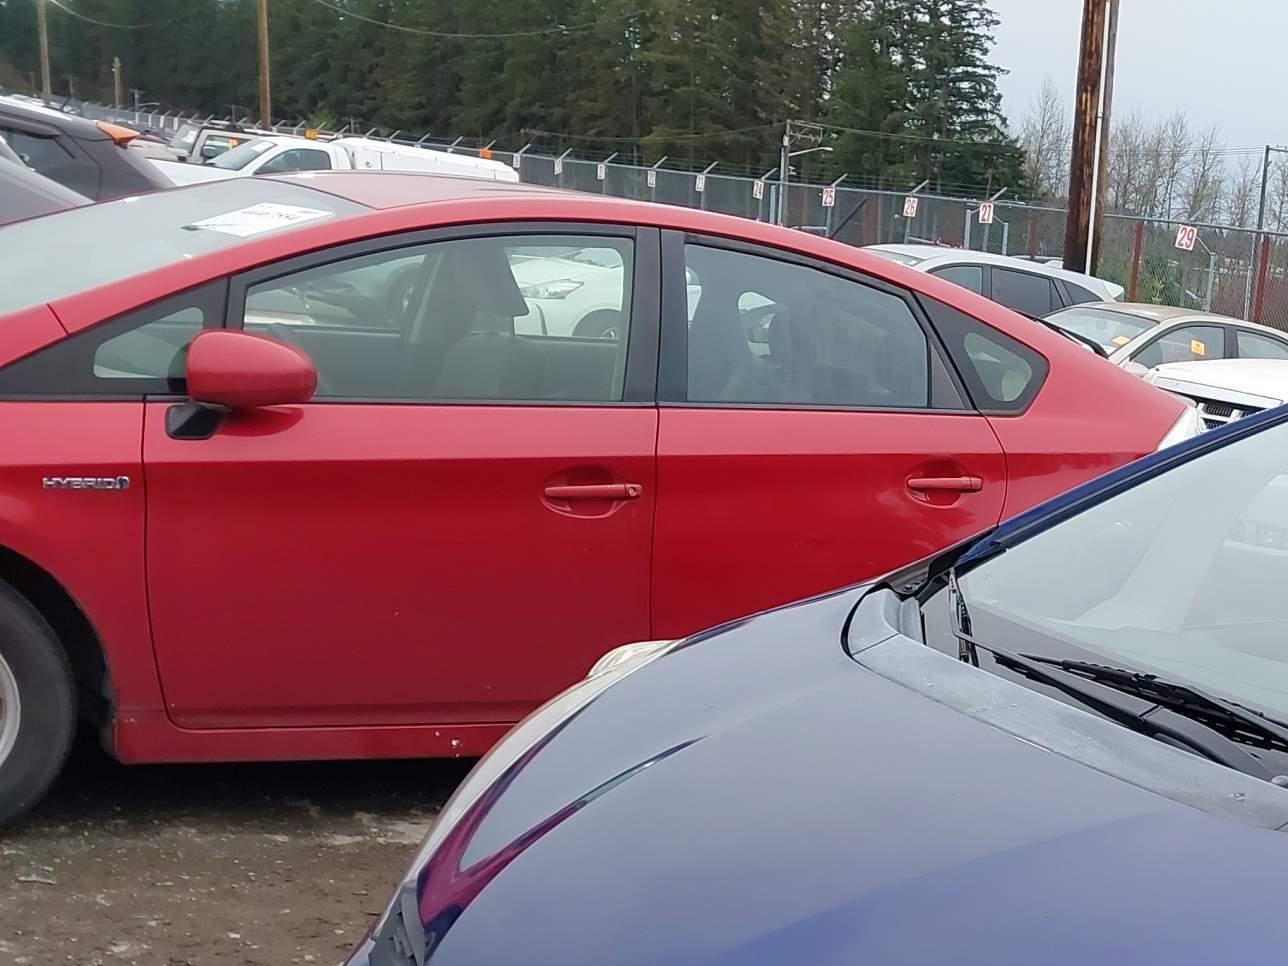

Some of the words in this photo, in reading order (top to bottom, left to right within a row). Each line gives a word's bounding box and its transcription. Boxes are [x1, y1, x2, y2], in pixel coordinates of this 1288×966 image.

[823, 189, 834, 205] 25
[905, 198, 916, 215] 26
[981, 204, 992, 222] 27
[1177, 226, 1195, 249] 29
[43, 477, 116, 489] HYBRID
